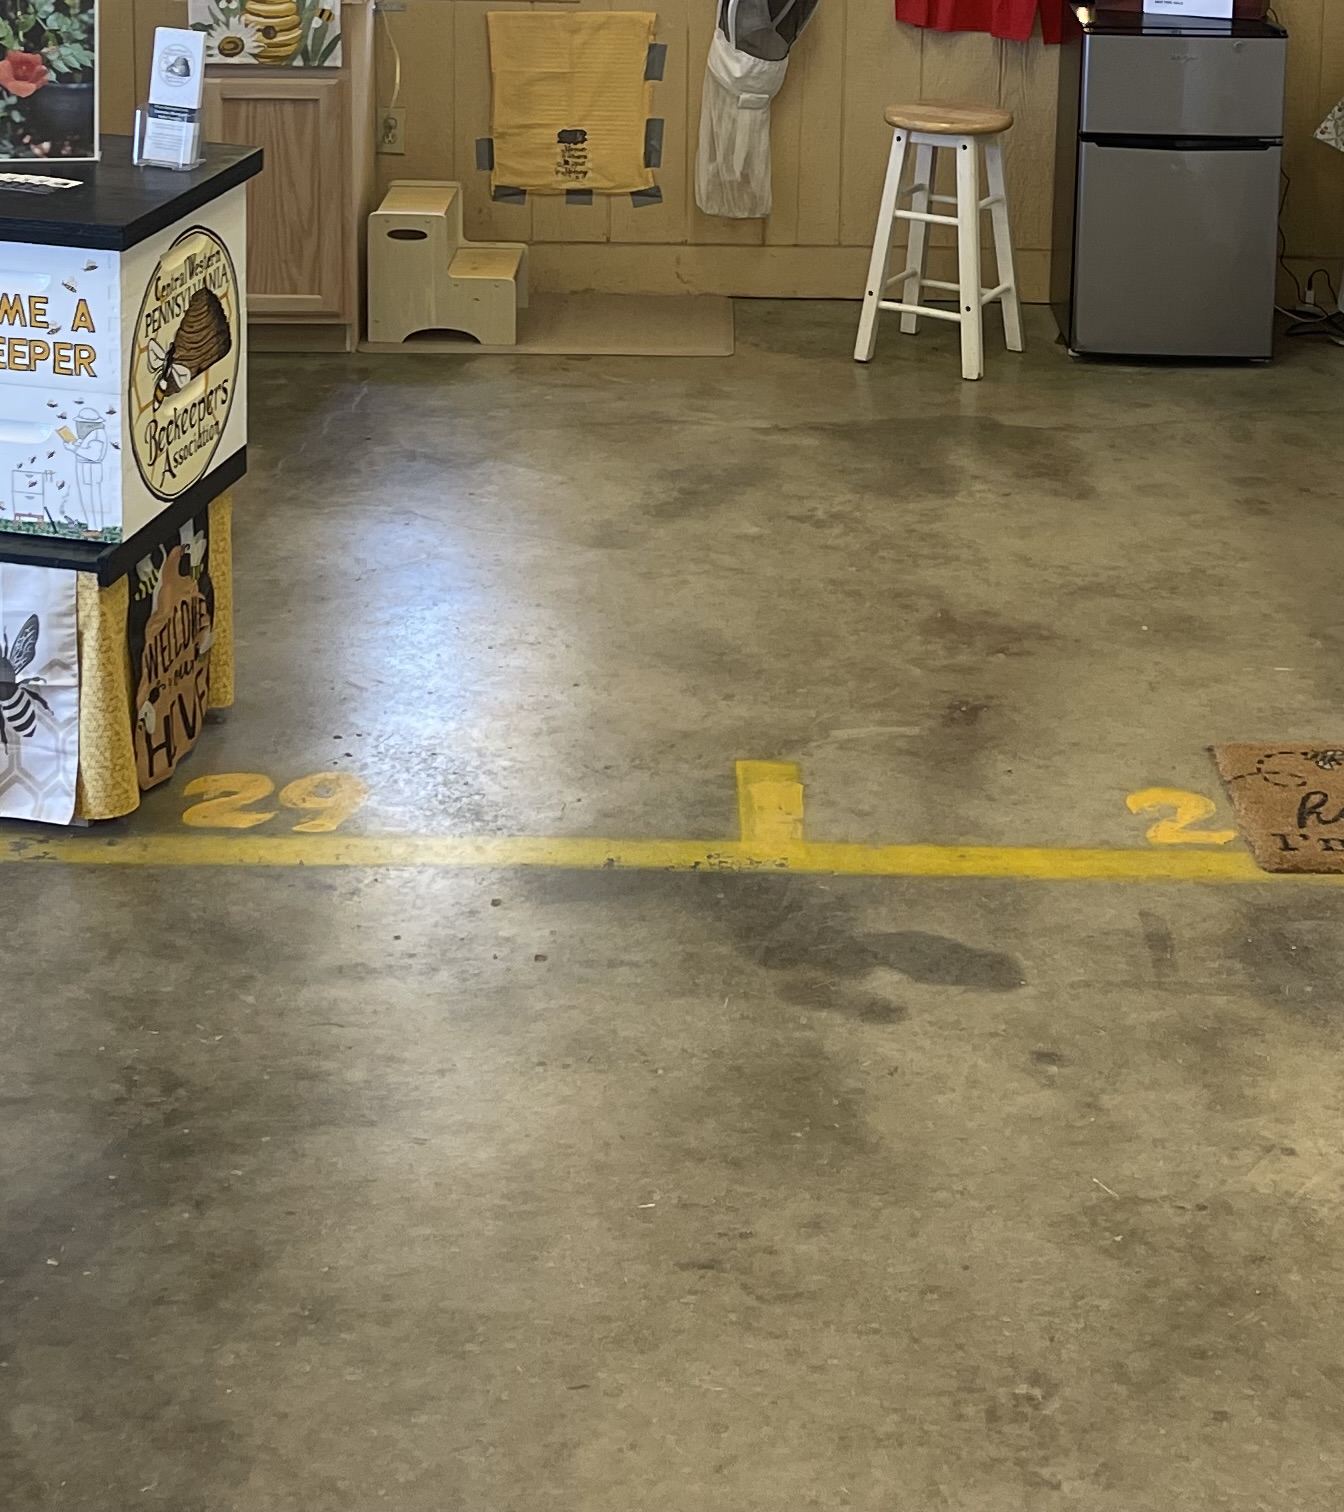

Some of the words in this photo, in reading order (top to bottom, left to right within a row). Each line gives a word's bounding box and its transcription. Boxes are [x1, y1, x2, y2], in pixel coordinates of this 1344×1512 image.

[155, 258, 187, 302] Central
[184, 249, 222, 281] Western
[71, 298, 96, 334] A
[144, 378, 229, 467] Beekeepers
[159, 419, 221, 489] Association
[145, 595, 209, 684] WELCOME
[145, 666, 207, 779] HIVE
[182, 771, 372, 833] 29
